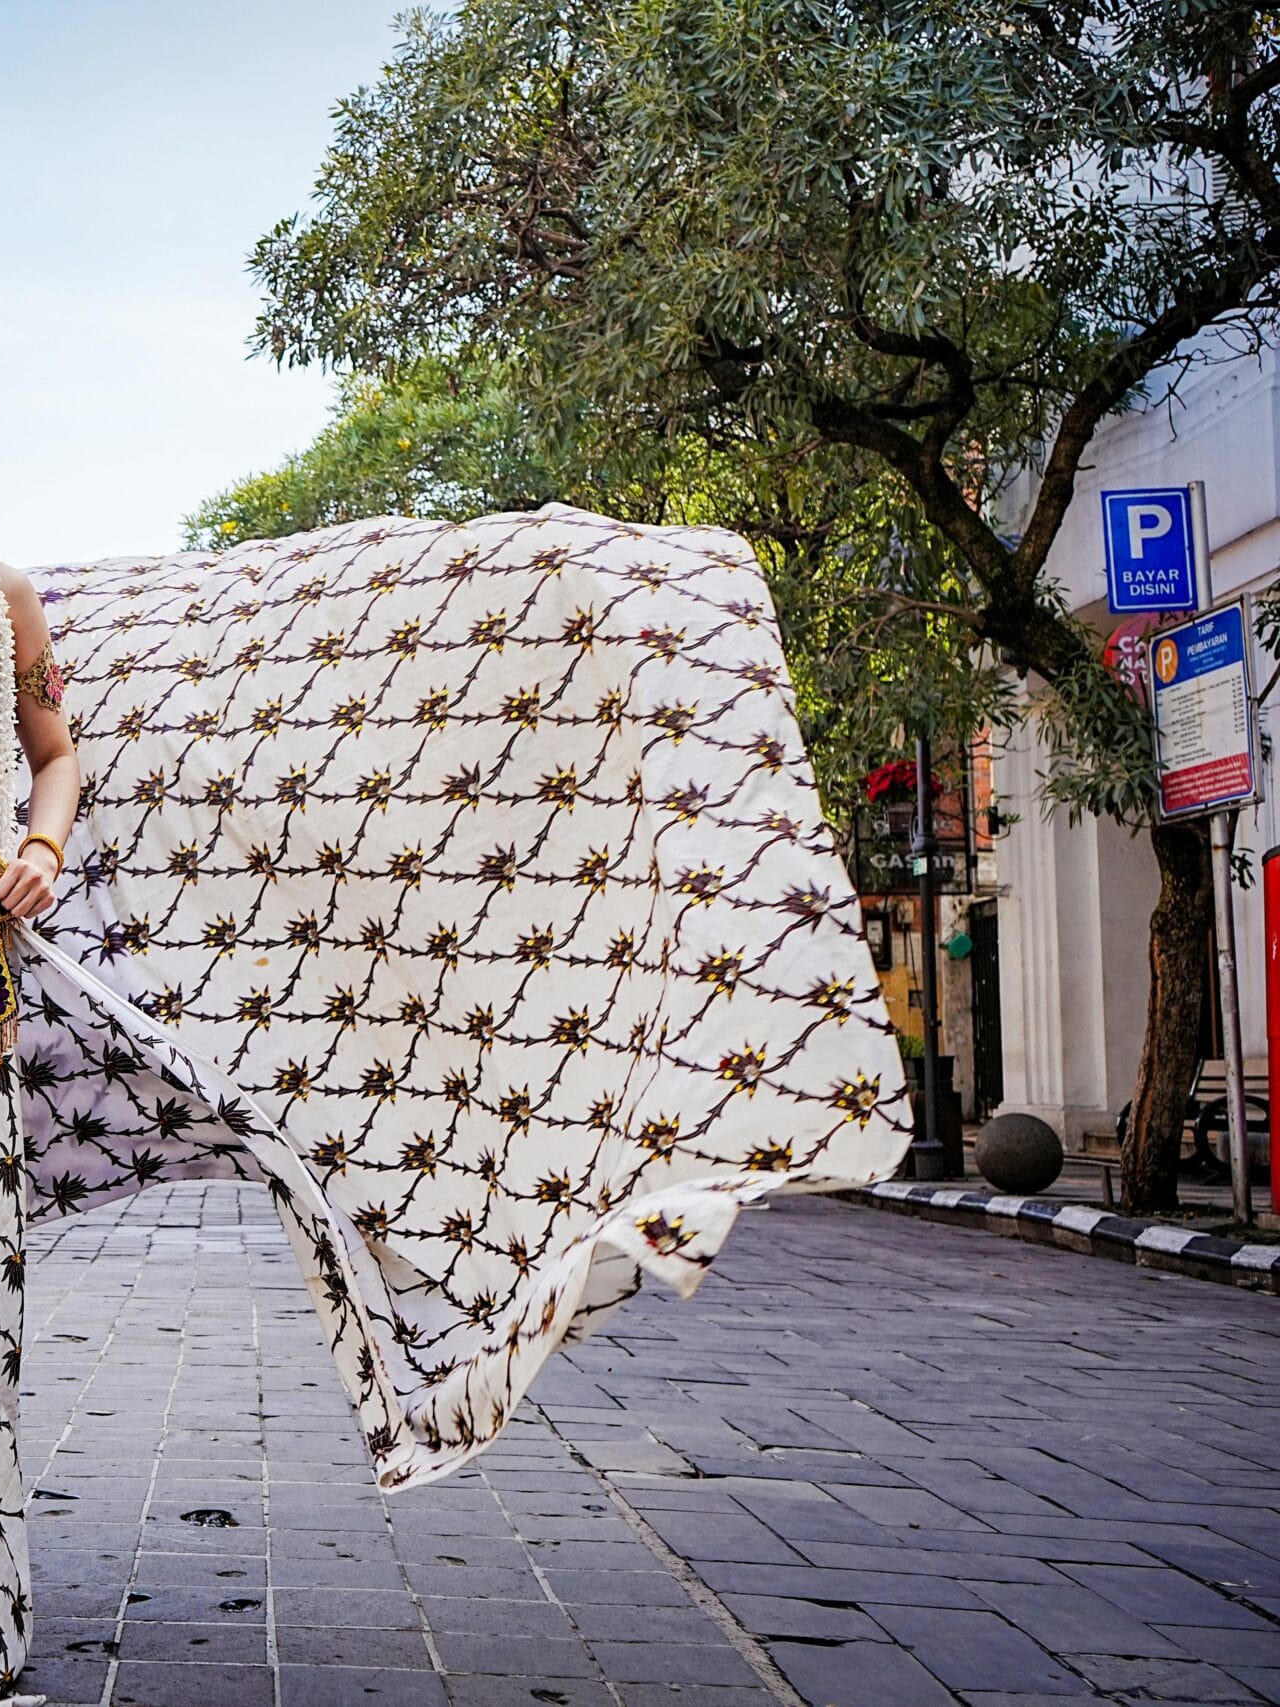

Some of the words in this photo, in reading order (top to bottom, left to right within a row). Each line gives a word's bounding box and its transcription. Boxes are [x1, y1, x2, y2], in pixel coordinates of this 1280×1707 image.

[1127, 504, 1173, 559] P
[1123, 568, 1180, 583] BAYAR
[1130, 582, 1175, 596] DISINI
